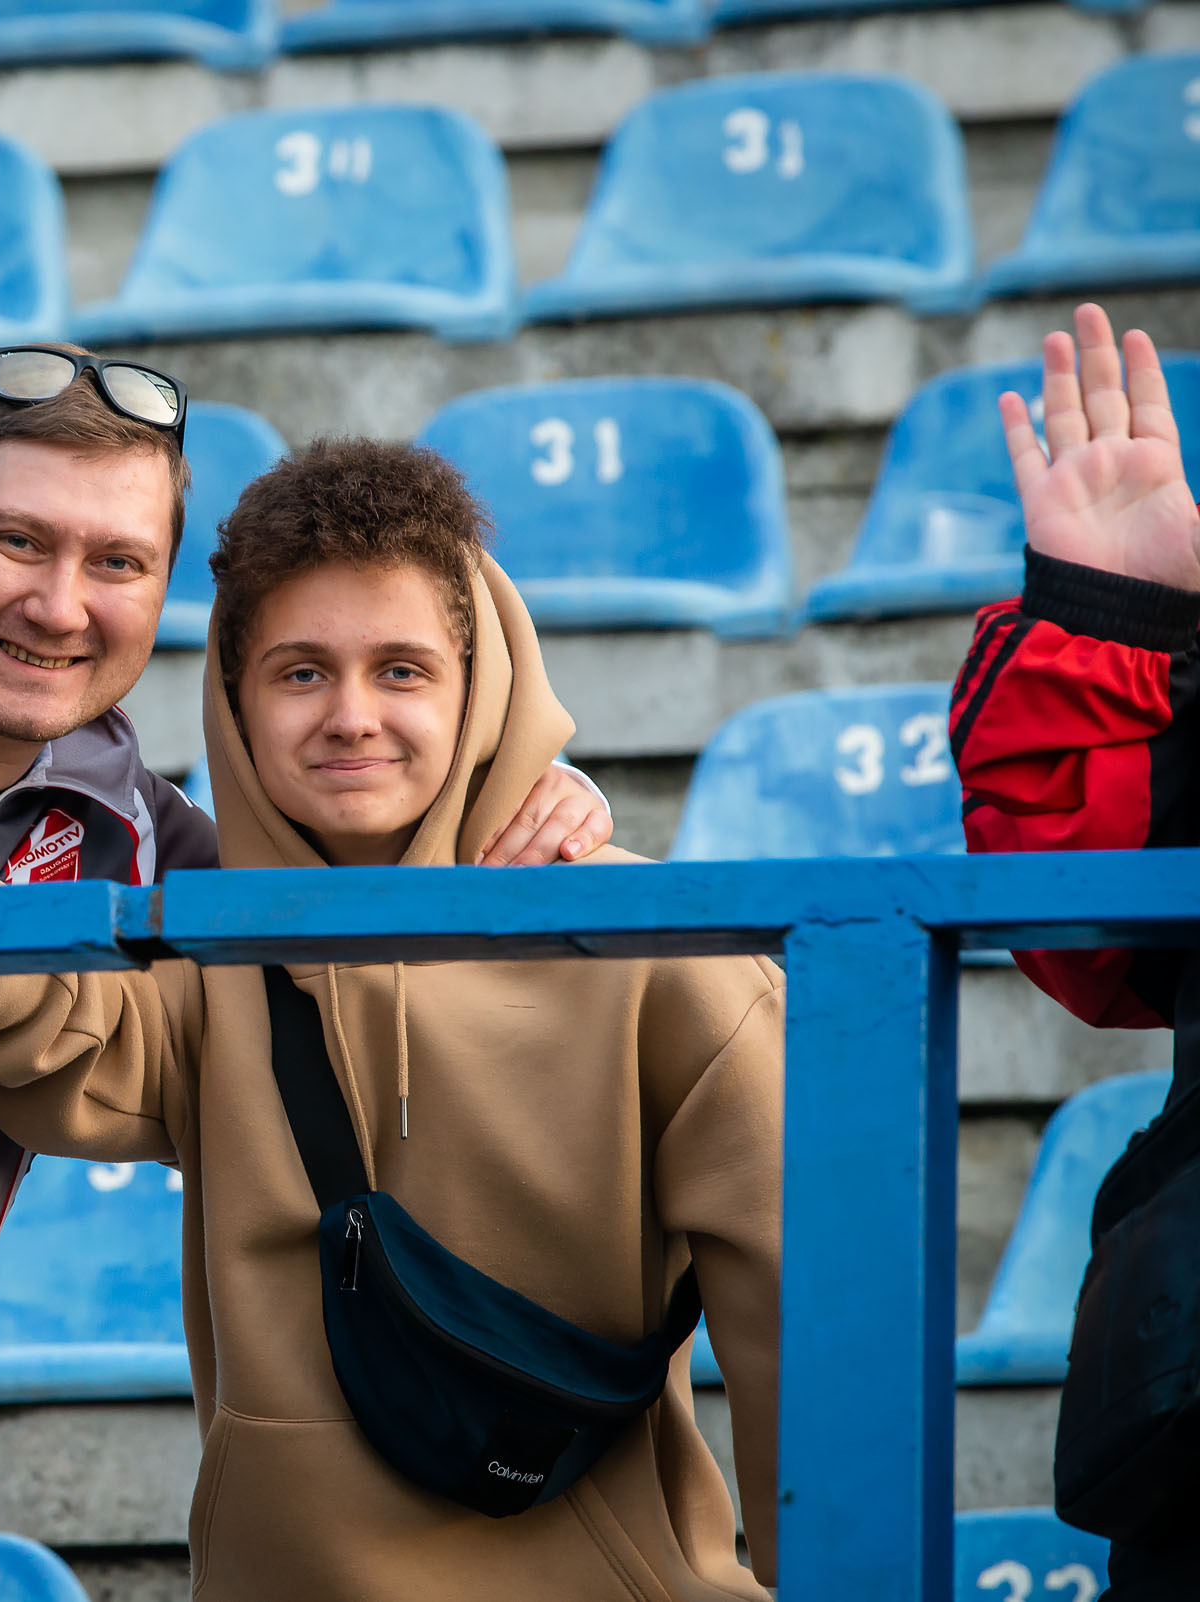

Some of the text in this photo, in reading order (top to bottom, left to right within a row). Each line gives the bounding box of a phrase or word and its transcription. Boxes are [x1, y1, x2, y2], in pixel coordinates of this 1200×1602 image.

[530, 418, 624, 485] 31
[835, 713, 950, 793] 32
[488, 1461, 544, 1484] Calvin Klein
